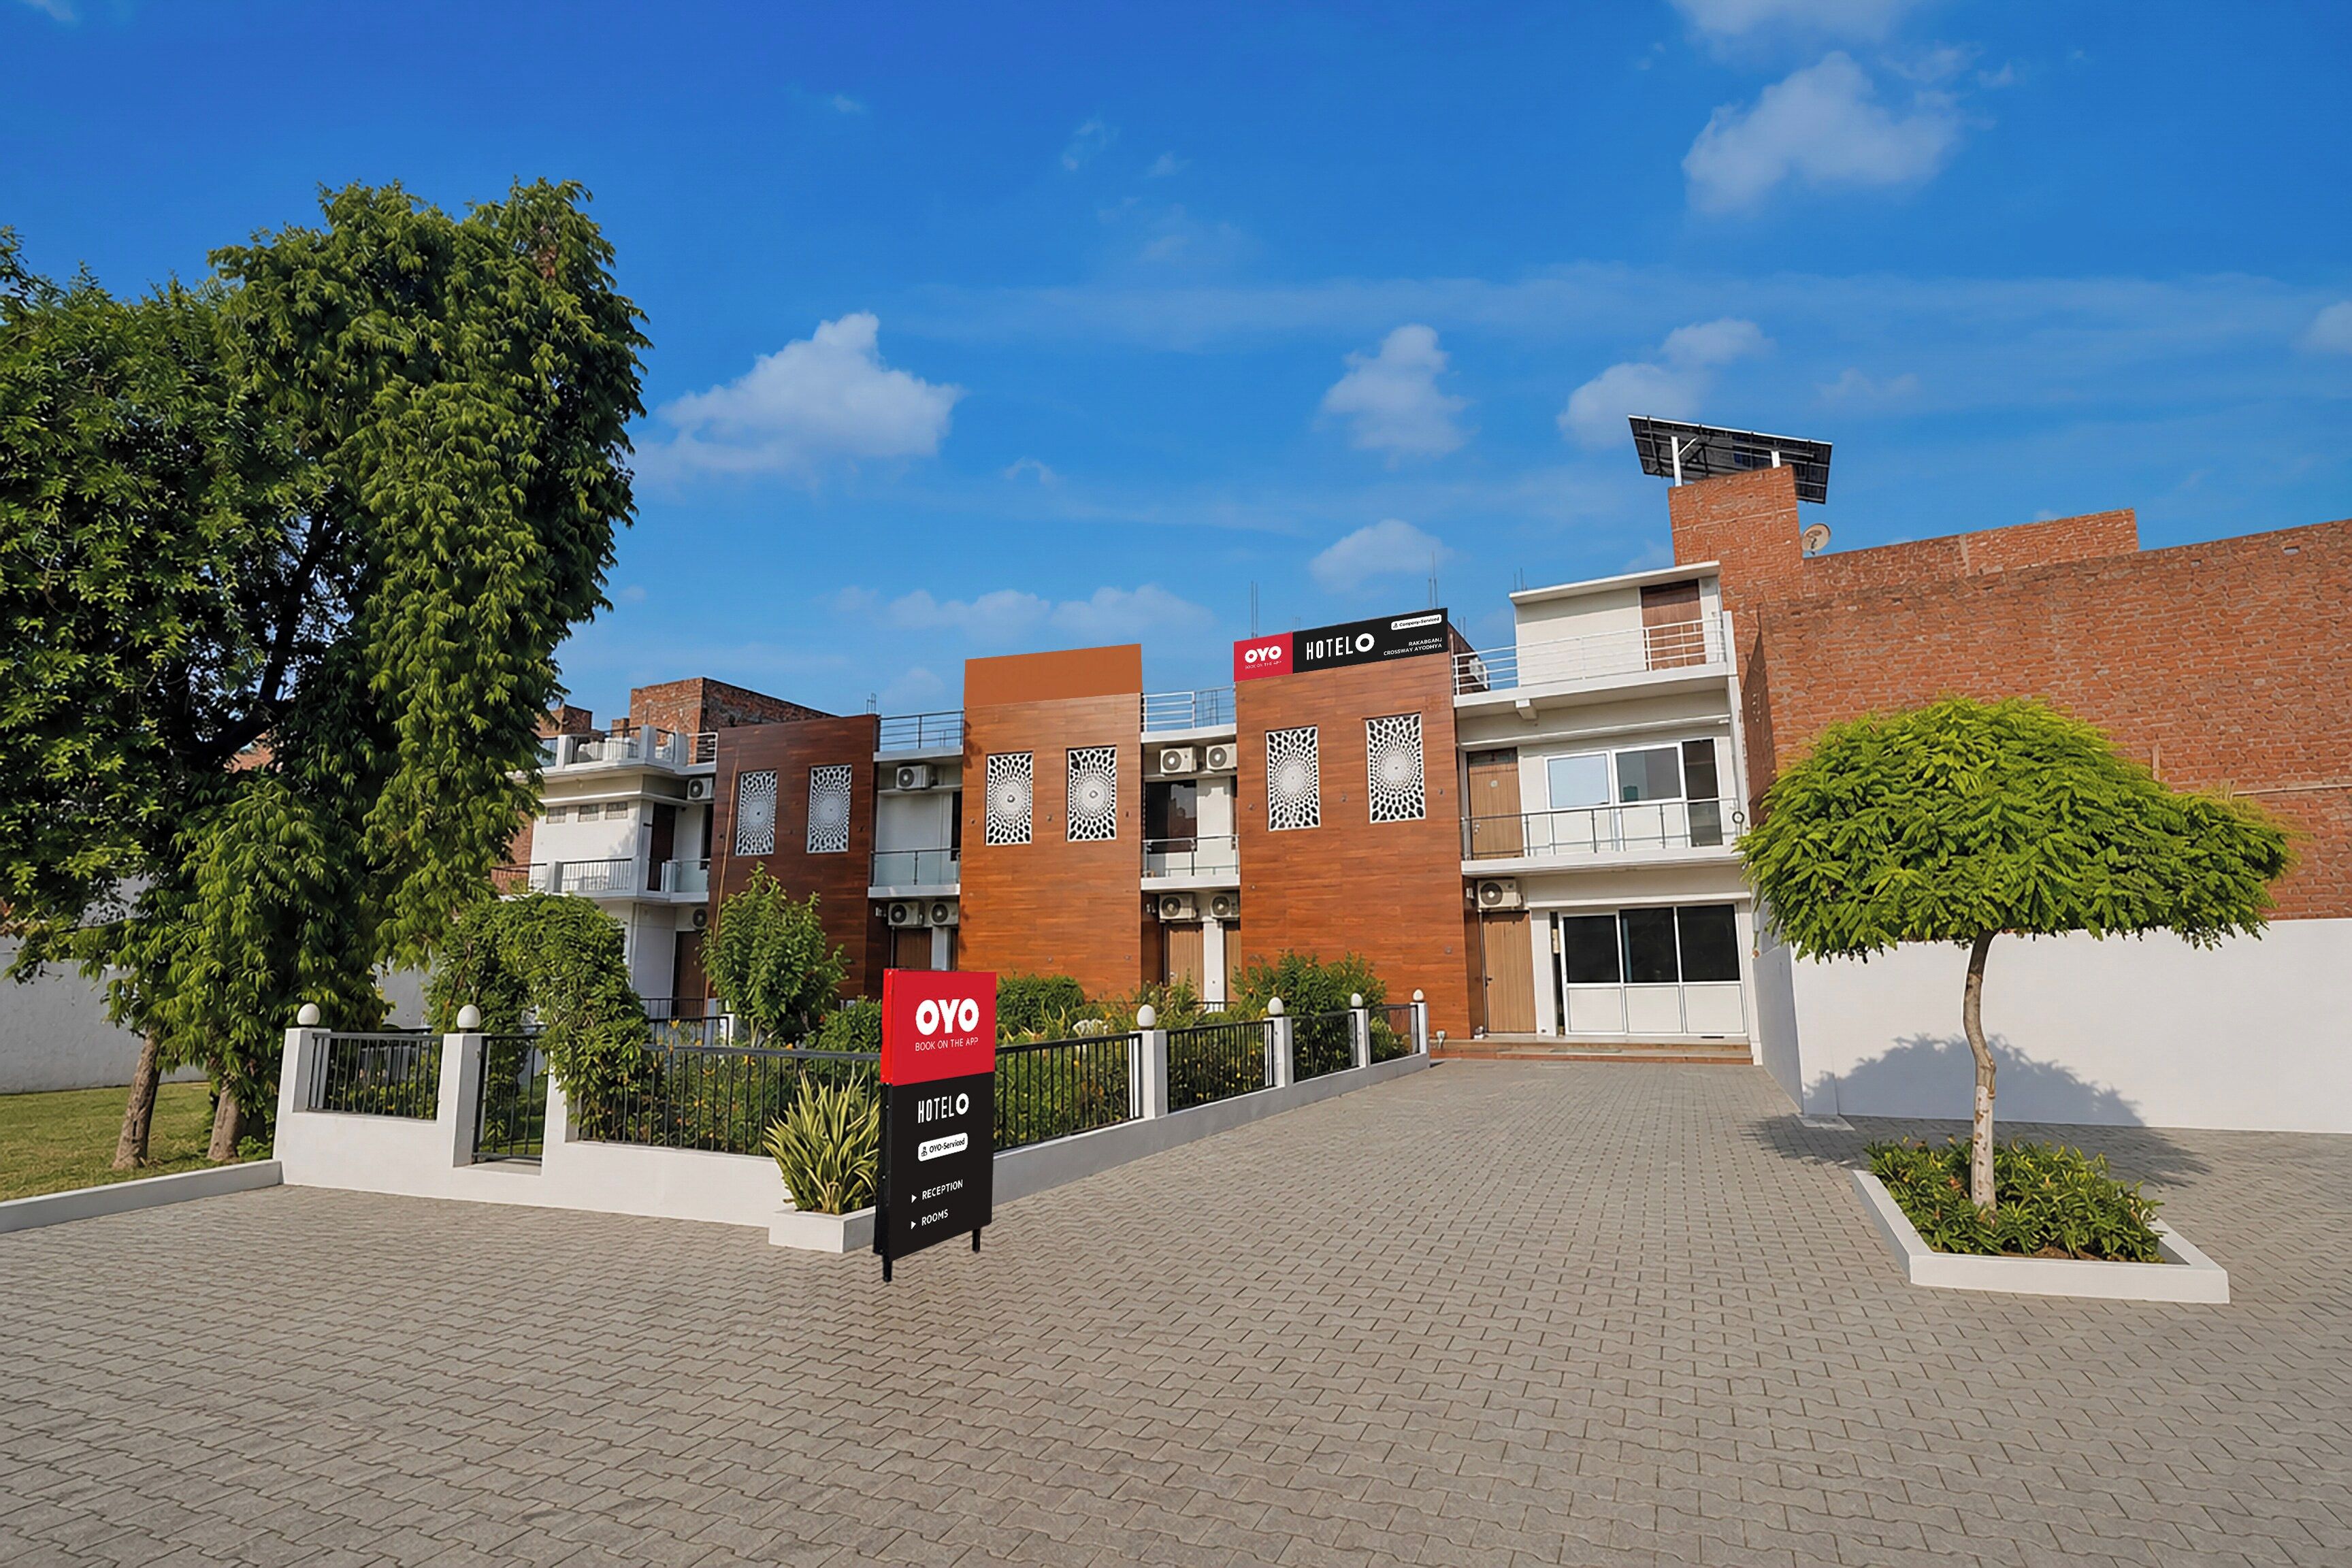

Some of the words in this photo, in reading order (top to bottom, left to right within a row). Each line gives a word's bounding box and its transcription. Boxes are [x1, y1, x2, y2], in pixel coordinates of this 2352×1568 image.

[1399, 617, 1439, 627] Company-Serviced
[1384, 647, 1413, 655] CROSSWAY
[1414, 643, 1442, 651] AYODHYA
[1408, 637, 1442, 647] RAKABGANJ
[1245, 645, 1282, 664] OYO
[915, 998, 979, 1036] OYO
[915, 1041, 936, 1051] BOOK
[937, 1039, 948, 1049] ON
[950, 1038, 964, 1047] THE
[965, 1036, 979, 1046] APP
[929, 1137, 965, 1153] OYO-Serviced
[922, 1179, 963, 1200] RECEPTION
[921, 1209, 949, 1226] ROOMS
